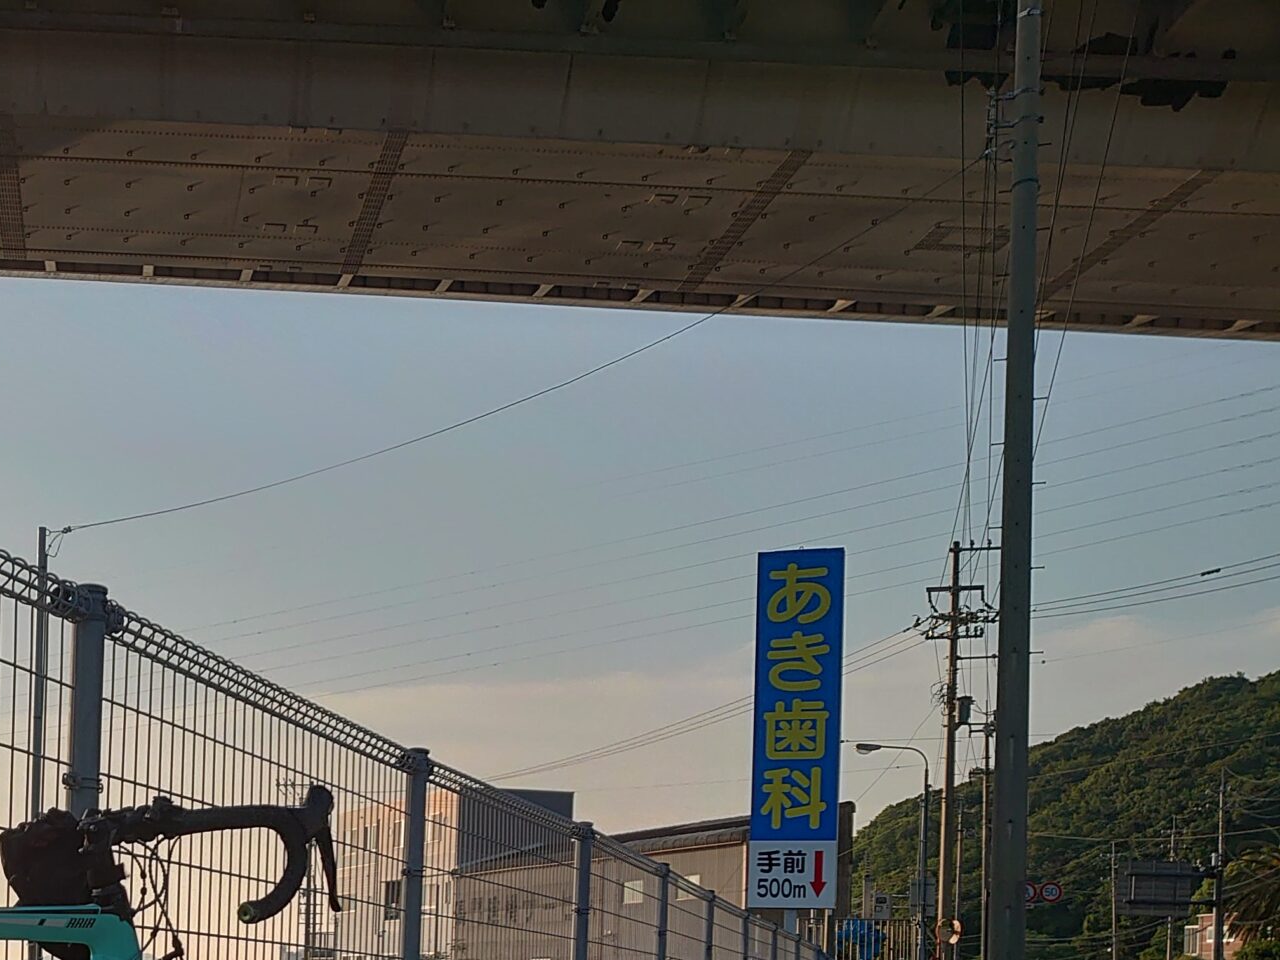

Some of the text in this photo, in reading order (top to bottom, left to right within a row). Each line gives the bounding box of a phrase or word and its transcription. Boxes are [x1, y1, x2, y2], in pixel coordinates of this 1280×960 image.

[760, 563, 831, 830] あき歯科
[756, 850, 807, 875] 手前
[756, 878, 807, 899] 500m
[1044, 886, 1058, 897] 50
